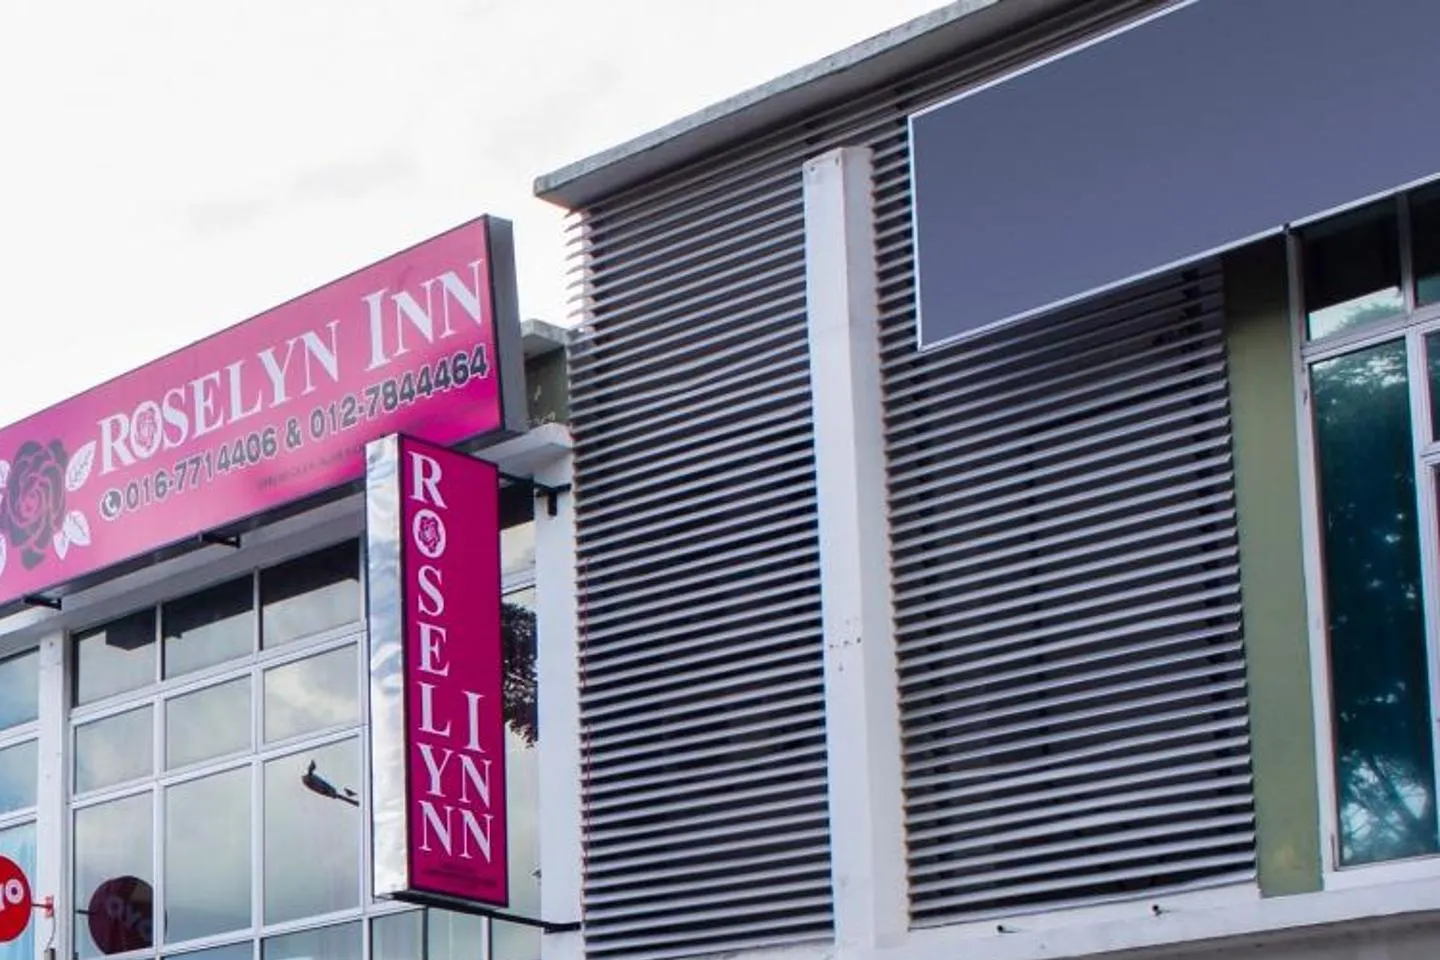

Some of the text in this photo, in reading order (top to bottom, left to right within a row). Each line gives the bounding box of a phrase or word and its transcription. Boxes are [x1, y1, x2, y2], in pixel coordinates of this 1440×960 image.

[96, 258, 484, 476] ROSELYN INN
[122, 428, 278, 511] 016-7714406
[284, 416, 303, 450] &
[310, 344, 488, 438] 012-7844464
[407, 451, 455, 859] ROSELYN
[458, 689, 493, 866] INN
